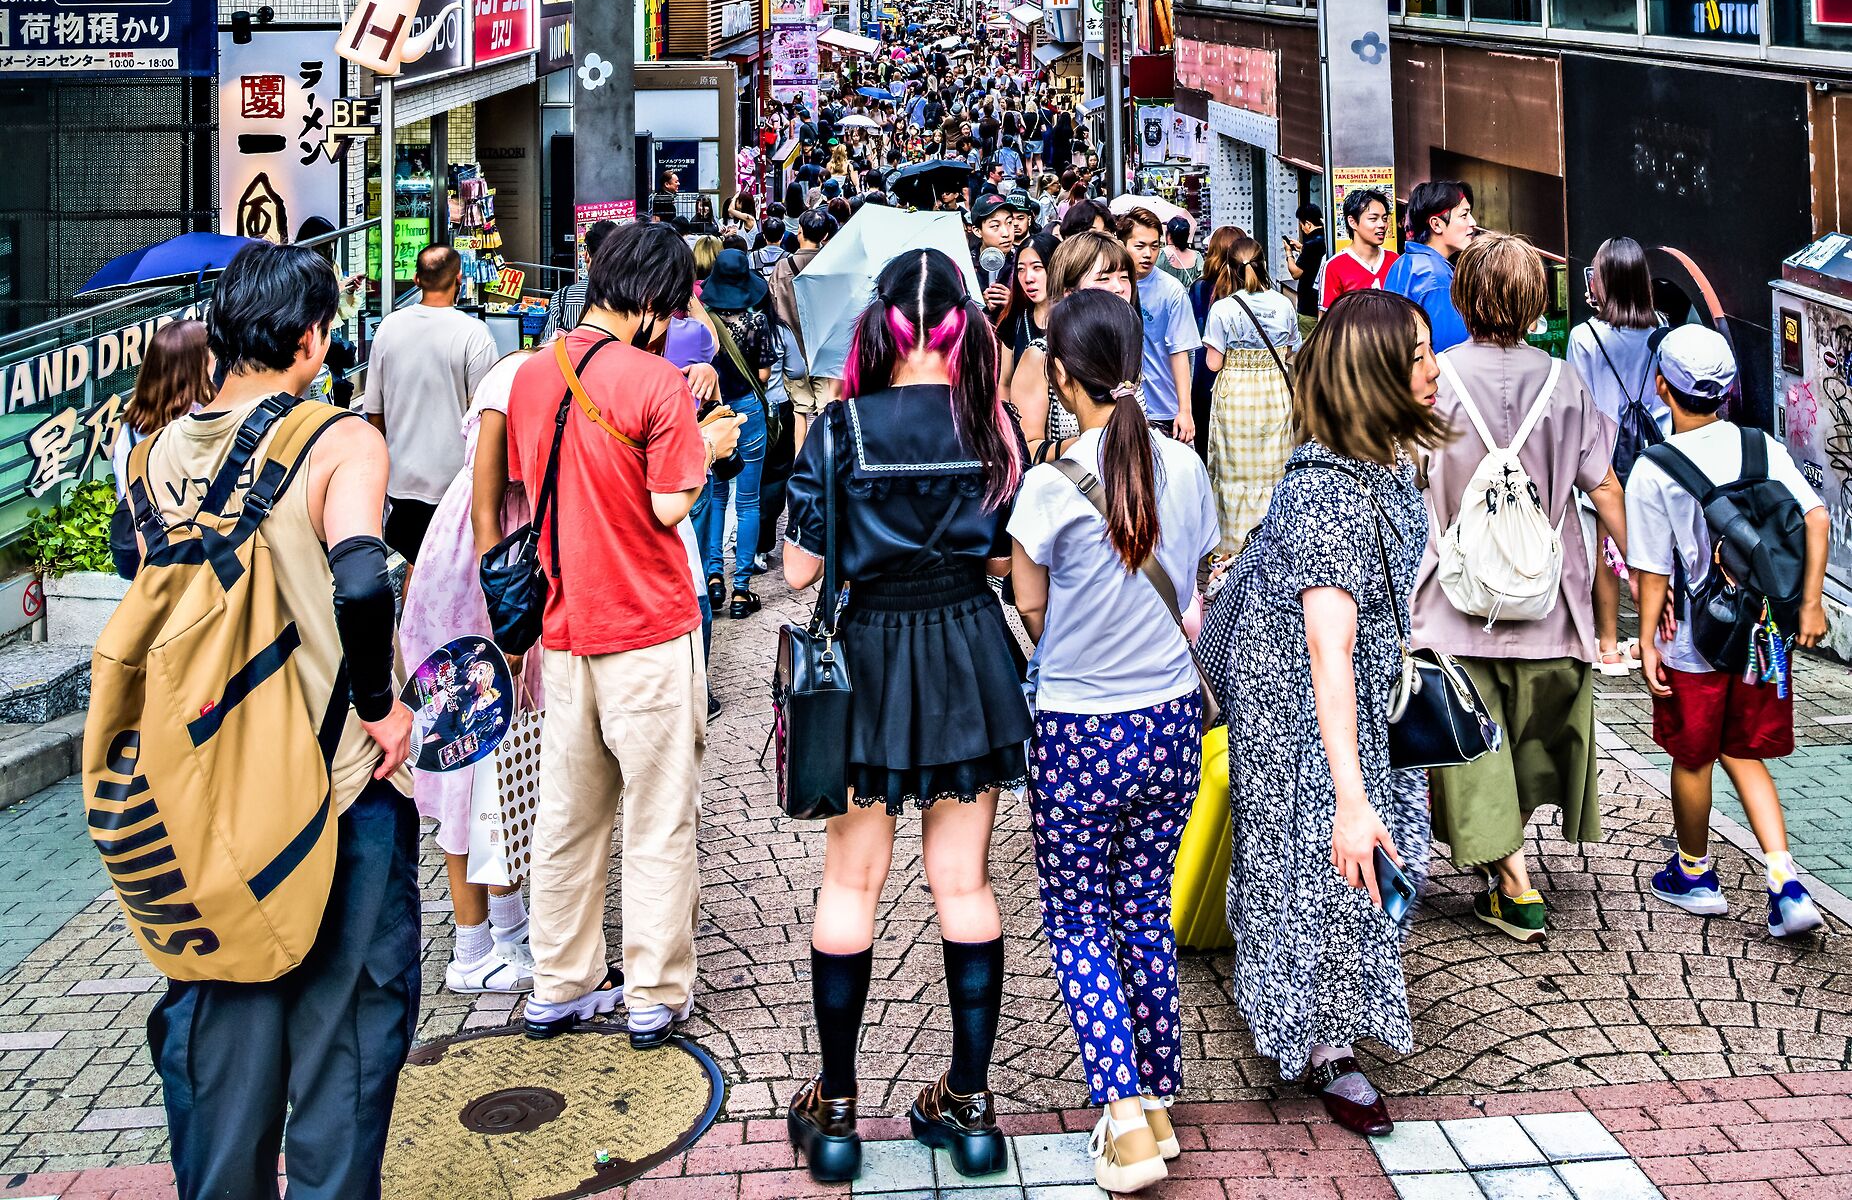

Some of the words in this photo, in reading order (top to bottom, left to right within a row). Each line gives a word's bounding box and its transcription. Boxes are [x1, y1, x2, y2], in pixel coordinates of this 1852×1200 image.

[19, 12, 170, 45] 荷物預かり
[350, 1, 407, 62] H
[491, 18, 512, 50] クスリ
[700, 76, 718, 85] 原宿
[298, 61, 324, 166] ラーメン
[333, 100, 367, 127] BF
[577, 207, 634, 219] 竹下通り公式マップ
